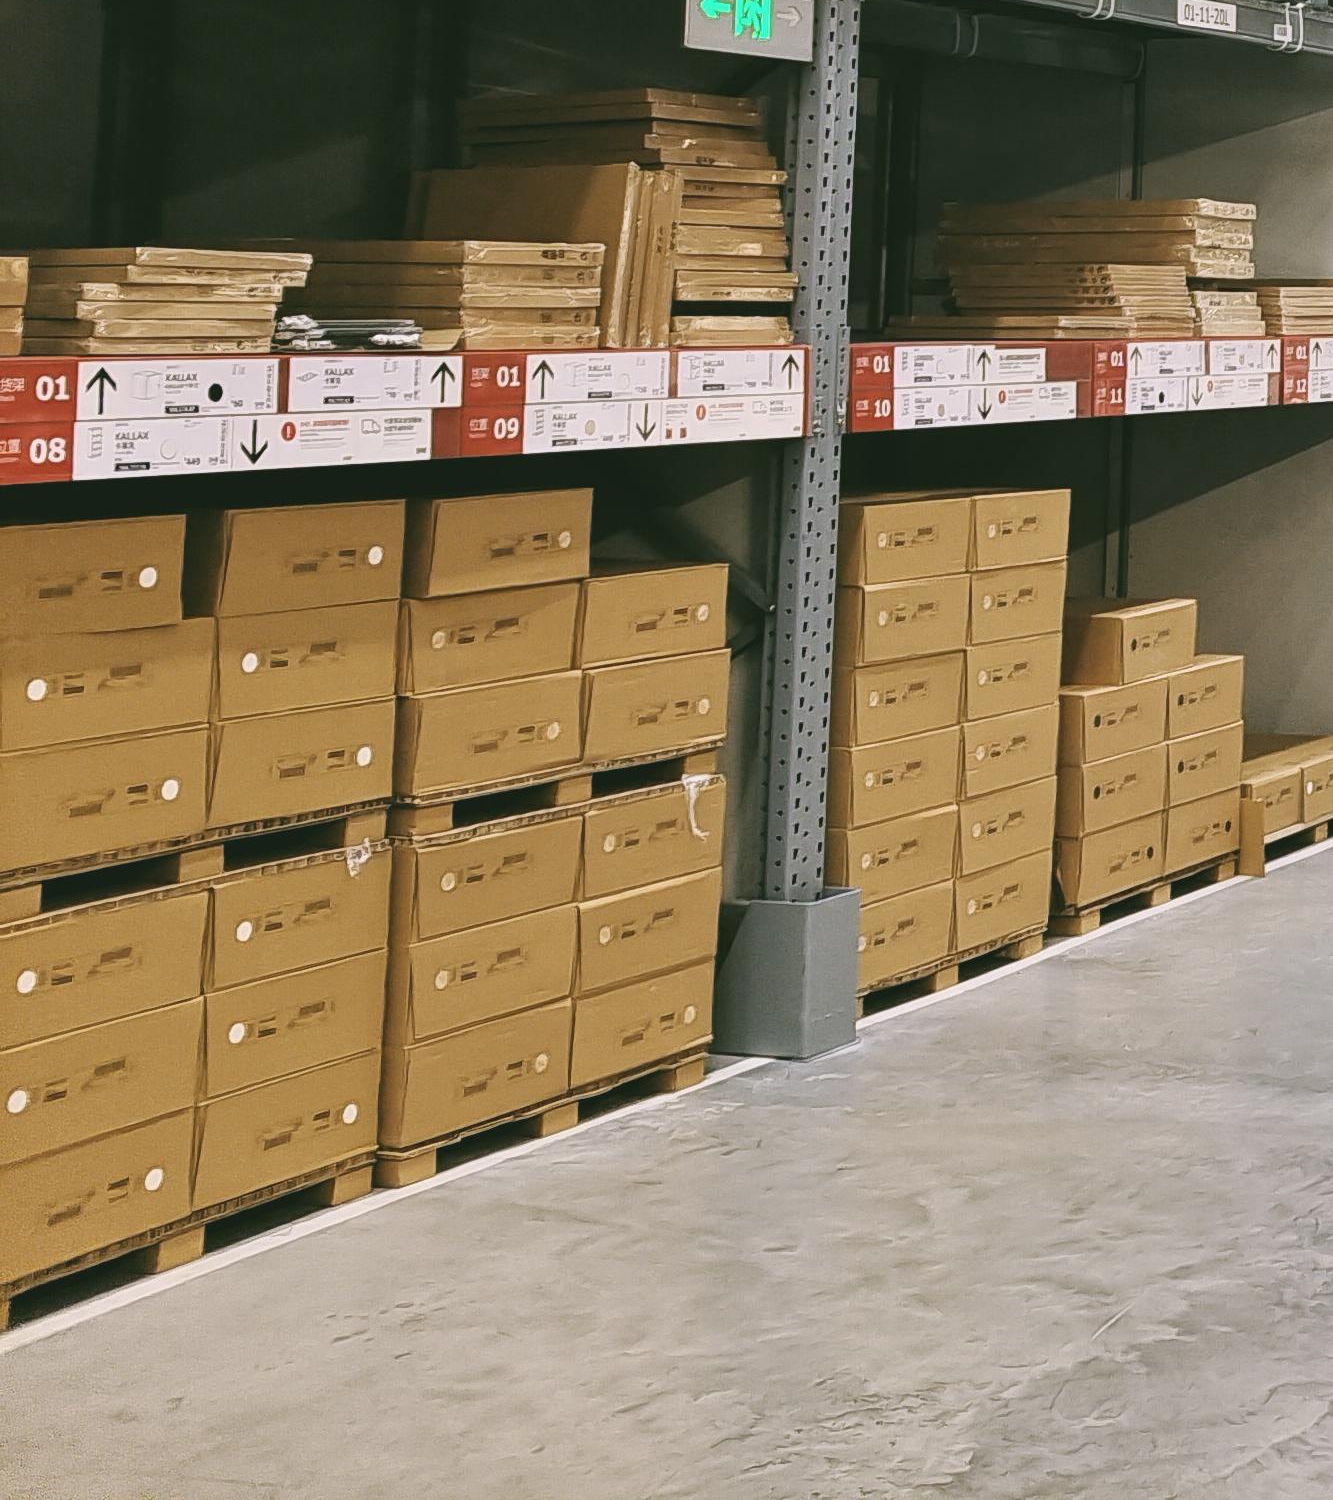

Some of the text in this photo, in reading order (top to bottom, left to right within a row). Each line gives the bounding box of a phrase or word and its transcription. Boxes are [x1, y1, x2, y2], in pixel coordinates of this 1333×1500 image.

[1184, 3, 1231, 28] 01-11-20L
[873, 356, 891, 374] 01
[1110, 351, 1124, 367] 01
[165, 373, 198, 382] KALLAX
[496, 366, 521, 388] 01
[35, 375, 70, 401] 01
[874, 400, 892, 419] 10
[115, 431, 150, 441] KALLAX
[494, 418, 521, 440] 09
[29, 437, 67, 463] 08
